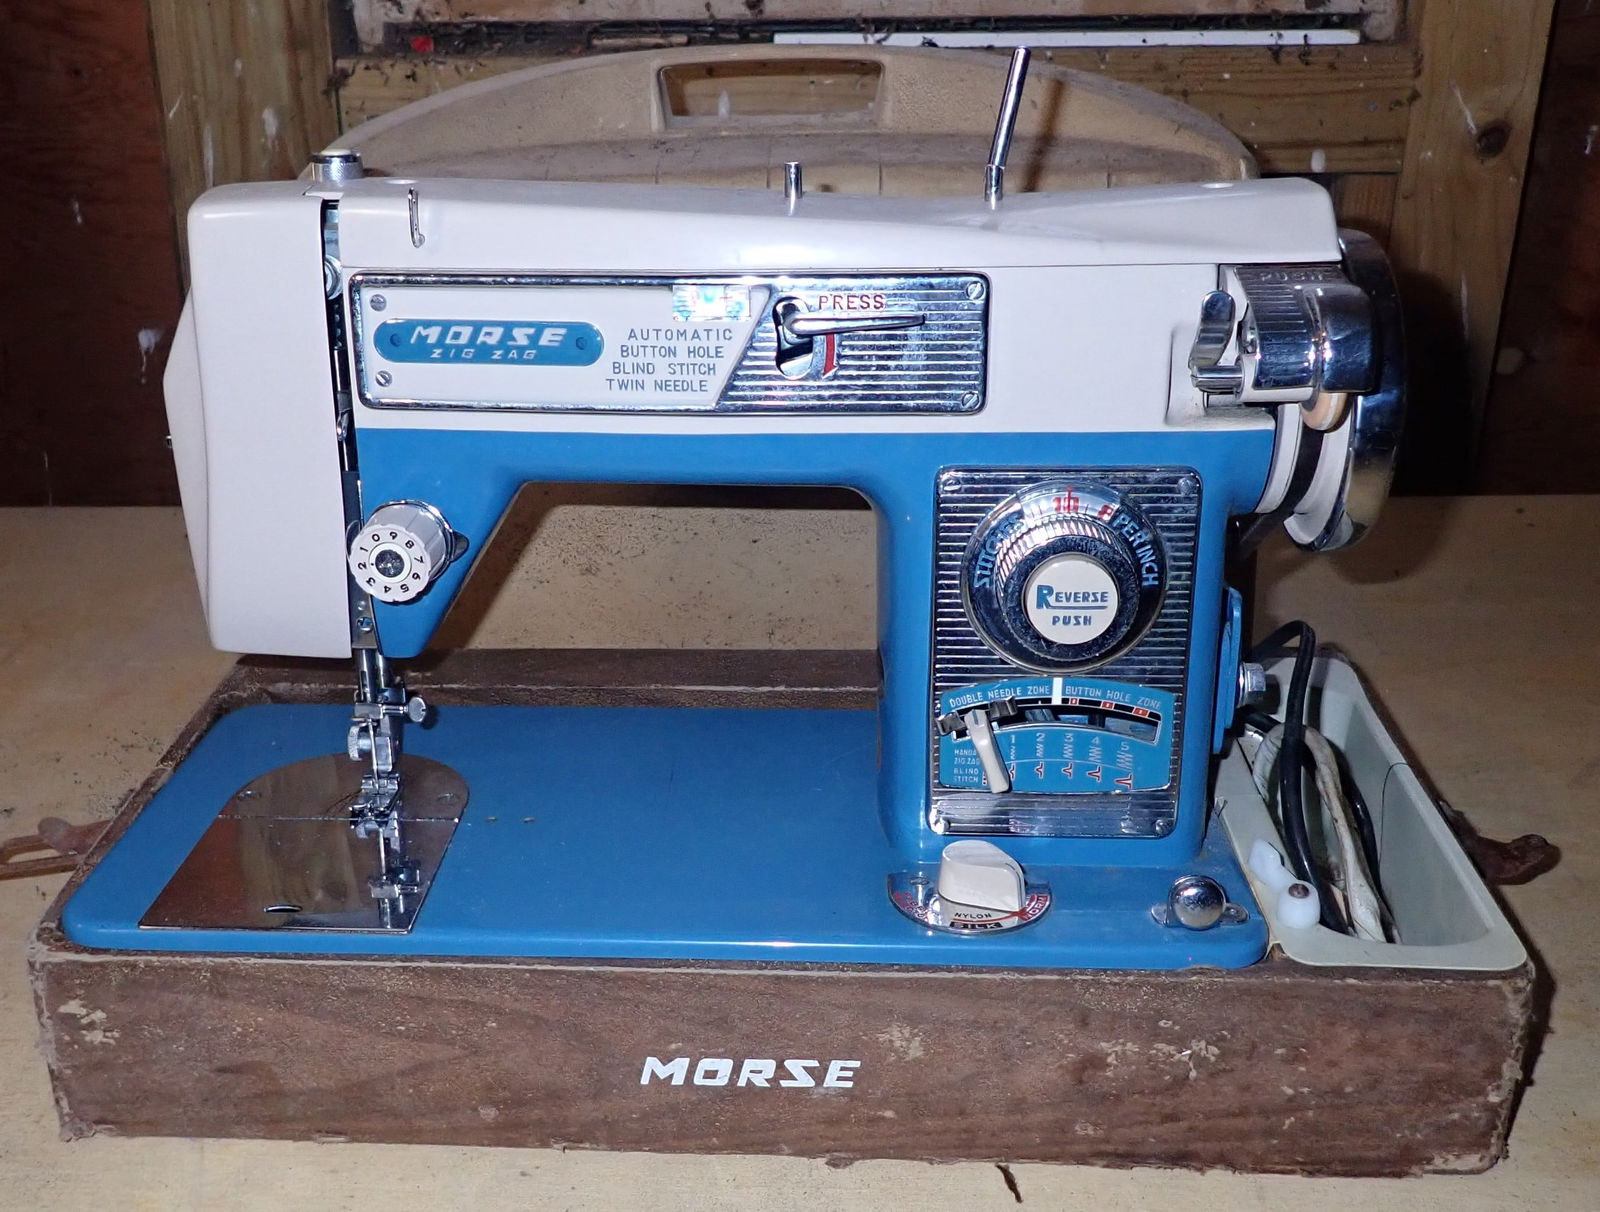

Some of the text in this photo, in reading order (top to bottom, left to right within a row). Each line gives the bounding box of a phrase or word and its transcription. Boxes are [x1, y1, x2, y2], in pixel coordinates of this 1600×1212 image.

[818, 294, 884, 311] PRESS
[410, 325, 568, 346] MORSE
[627, 328, 733, 342] AUTOMATIC
[430, 348, 537, 360] ZIG ZAG
[620, 345, 725, 359] BUTTON HOLE
[612, 361, 716, 376] BLIND STITCH
[606, 378, 708, 393] TWIN NEEDLE
[405, 540, 415, 549] 8
[1112, 513, 1159, 587] PER INCH
[414, 555, 424, 564] 7
[357, 561, 367, 570] 2
[366, 577, 376, 587] 3
[383, 585, 392, 594] 4
[400, 583, 410, 593] 5
[1035, 584, 1110, 610] REVERSE
[1052, 615, 1093, 626] PUSH
[949, 685, 1051, 708] DOUBLE NEEDLE ZONE
[1065, 685, 1101, 698] BUTTON
[1106, 690, 1131, 703] HOLE
[1137, 693, 1161, 711] ZONE
[1009, 734, 1016, 744] 1
[1036, 732, 1046, 742] 2
[1064, 732, 1074, 742] 3
[1091, 736, 1101, 745] 4
[1120, 741, 1130, 751] 5
[953, 922, 998, 930] SILK
[640, 1056, 861, 1088] MORSE
